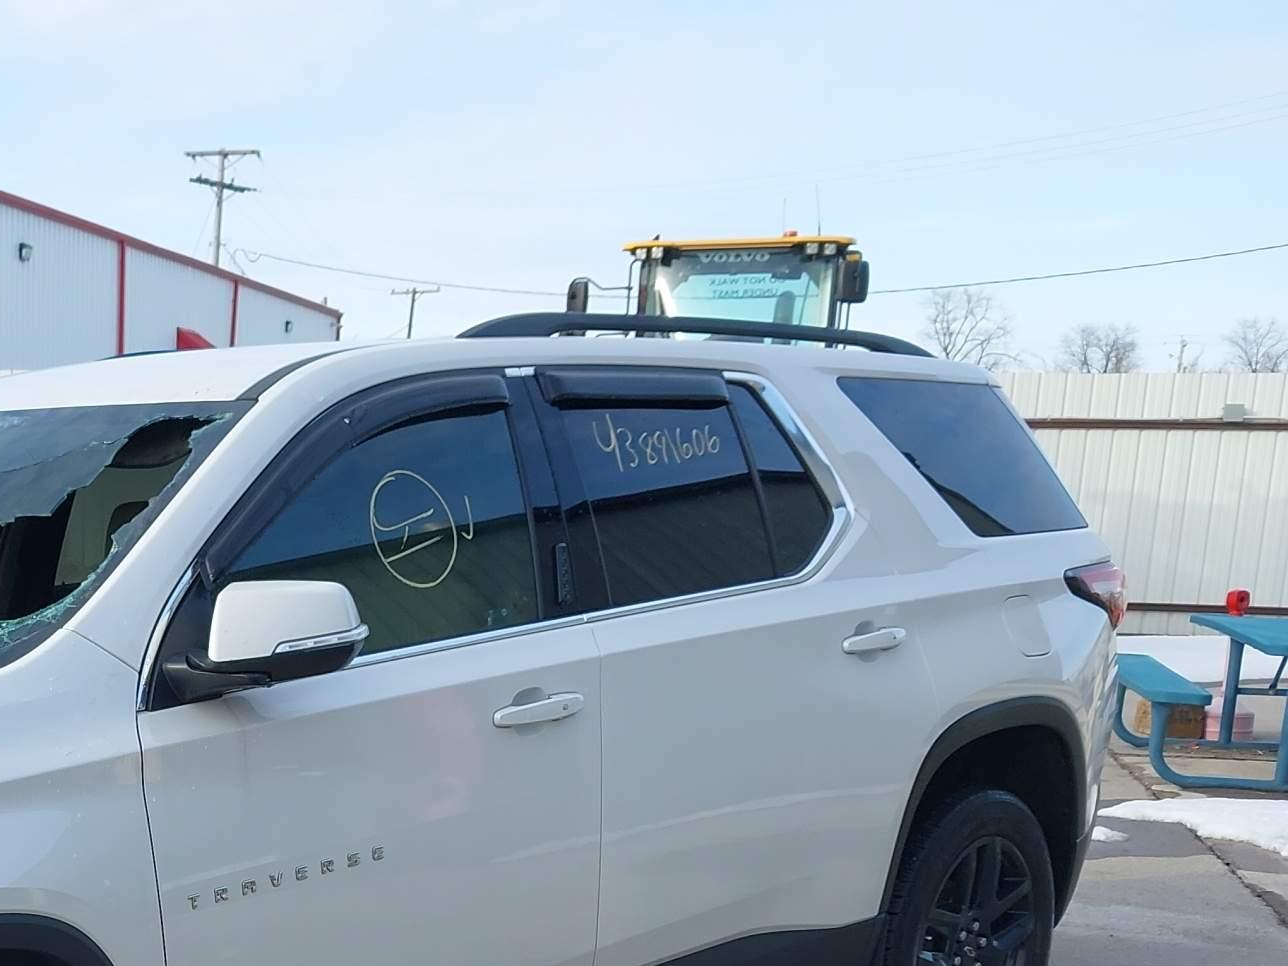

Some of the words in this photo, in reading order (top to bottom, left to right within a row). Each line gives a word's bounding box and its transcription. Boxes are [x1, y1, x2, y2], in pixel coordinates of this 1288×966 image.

[696, 252, 770, 263] VOLVO
[591, 413, 721, 473] 43891606
[186, 844, 385, 911] TRAVERSE
